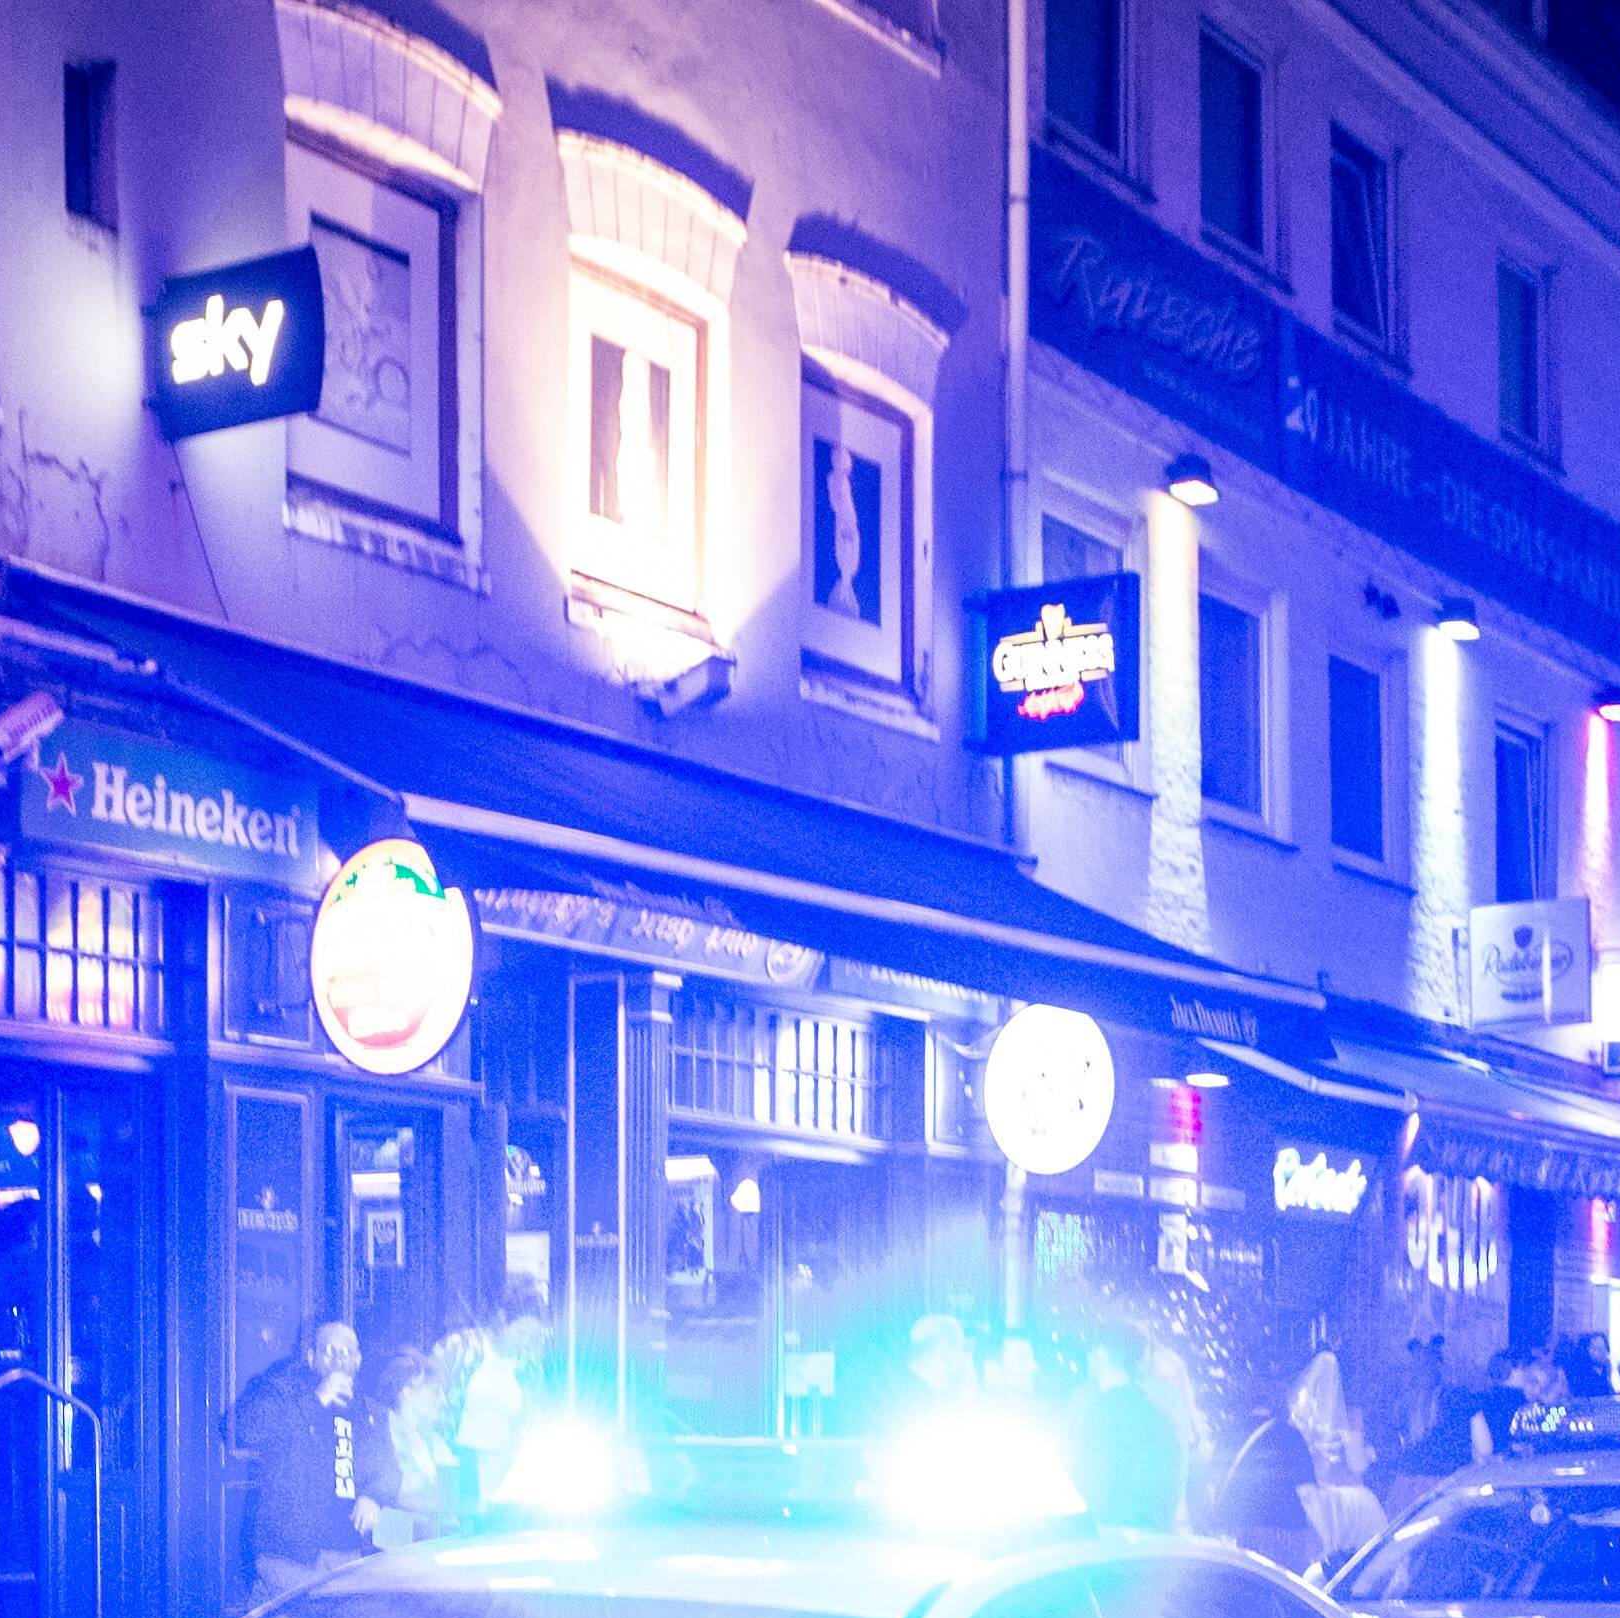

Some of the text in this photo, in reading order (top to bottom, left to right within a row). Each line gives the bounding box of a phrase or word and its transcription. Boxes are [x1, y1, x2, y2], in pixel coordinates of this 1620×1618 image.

[170, 293, 285, 387] sky
[1325, 400, 1411, 498] JAHRE
[91, 761, 304, 858] Heineken
